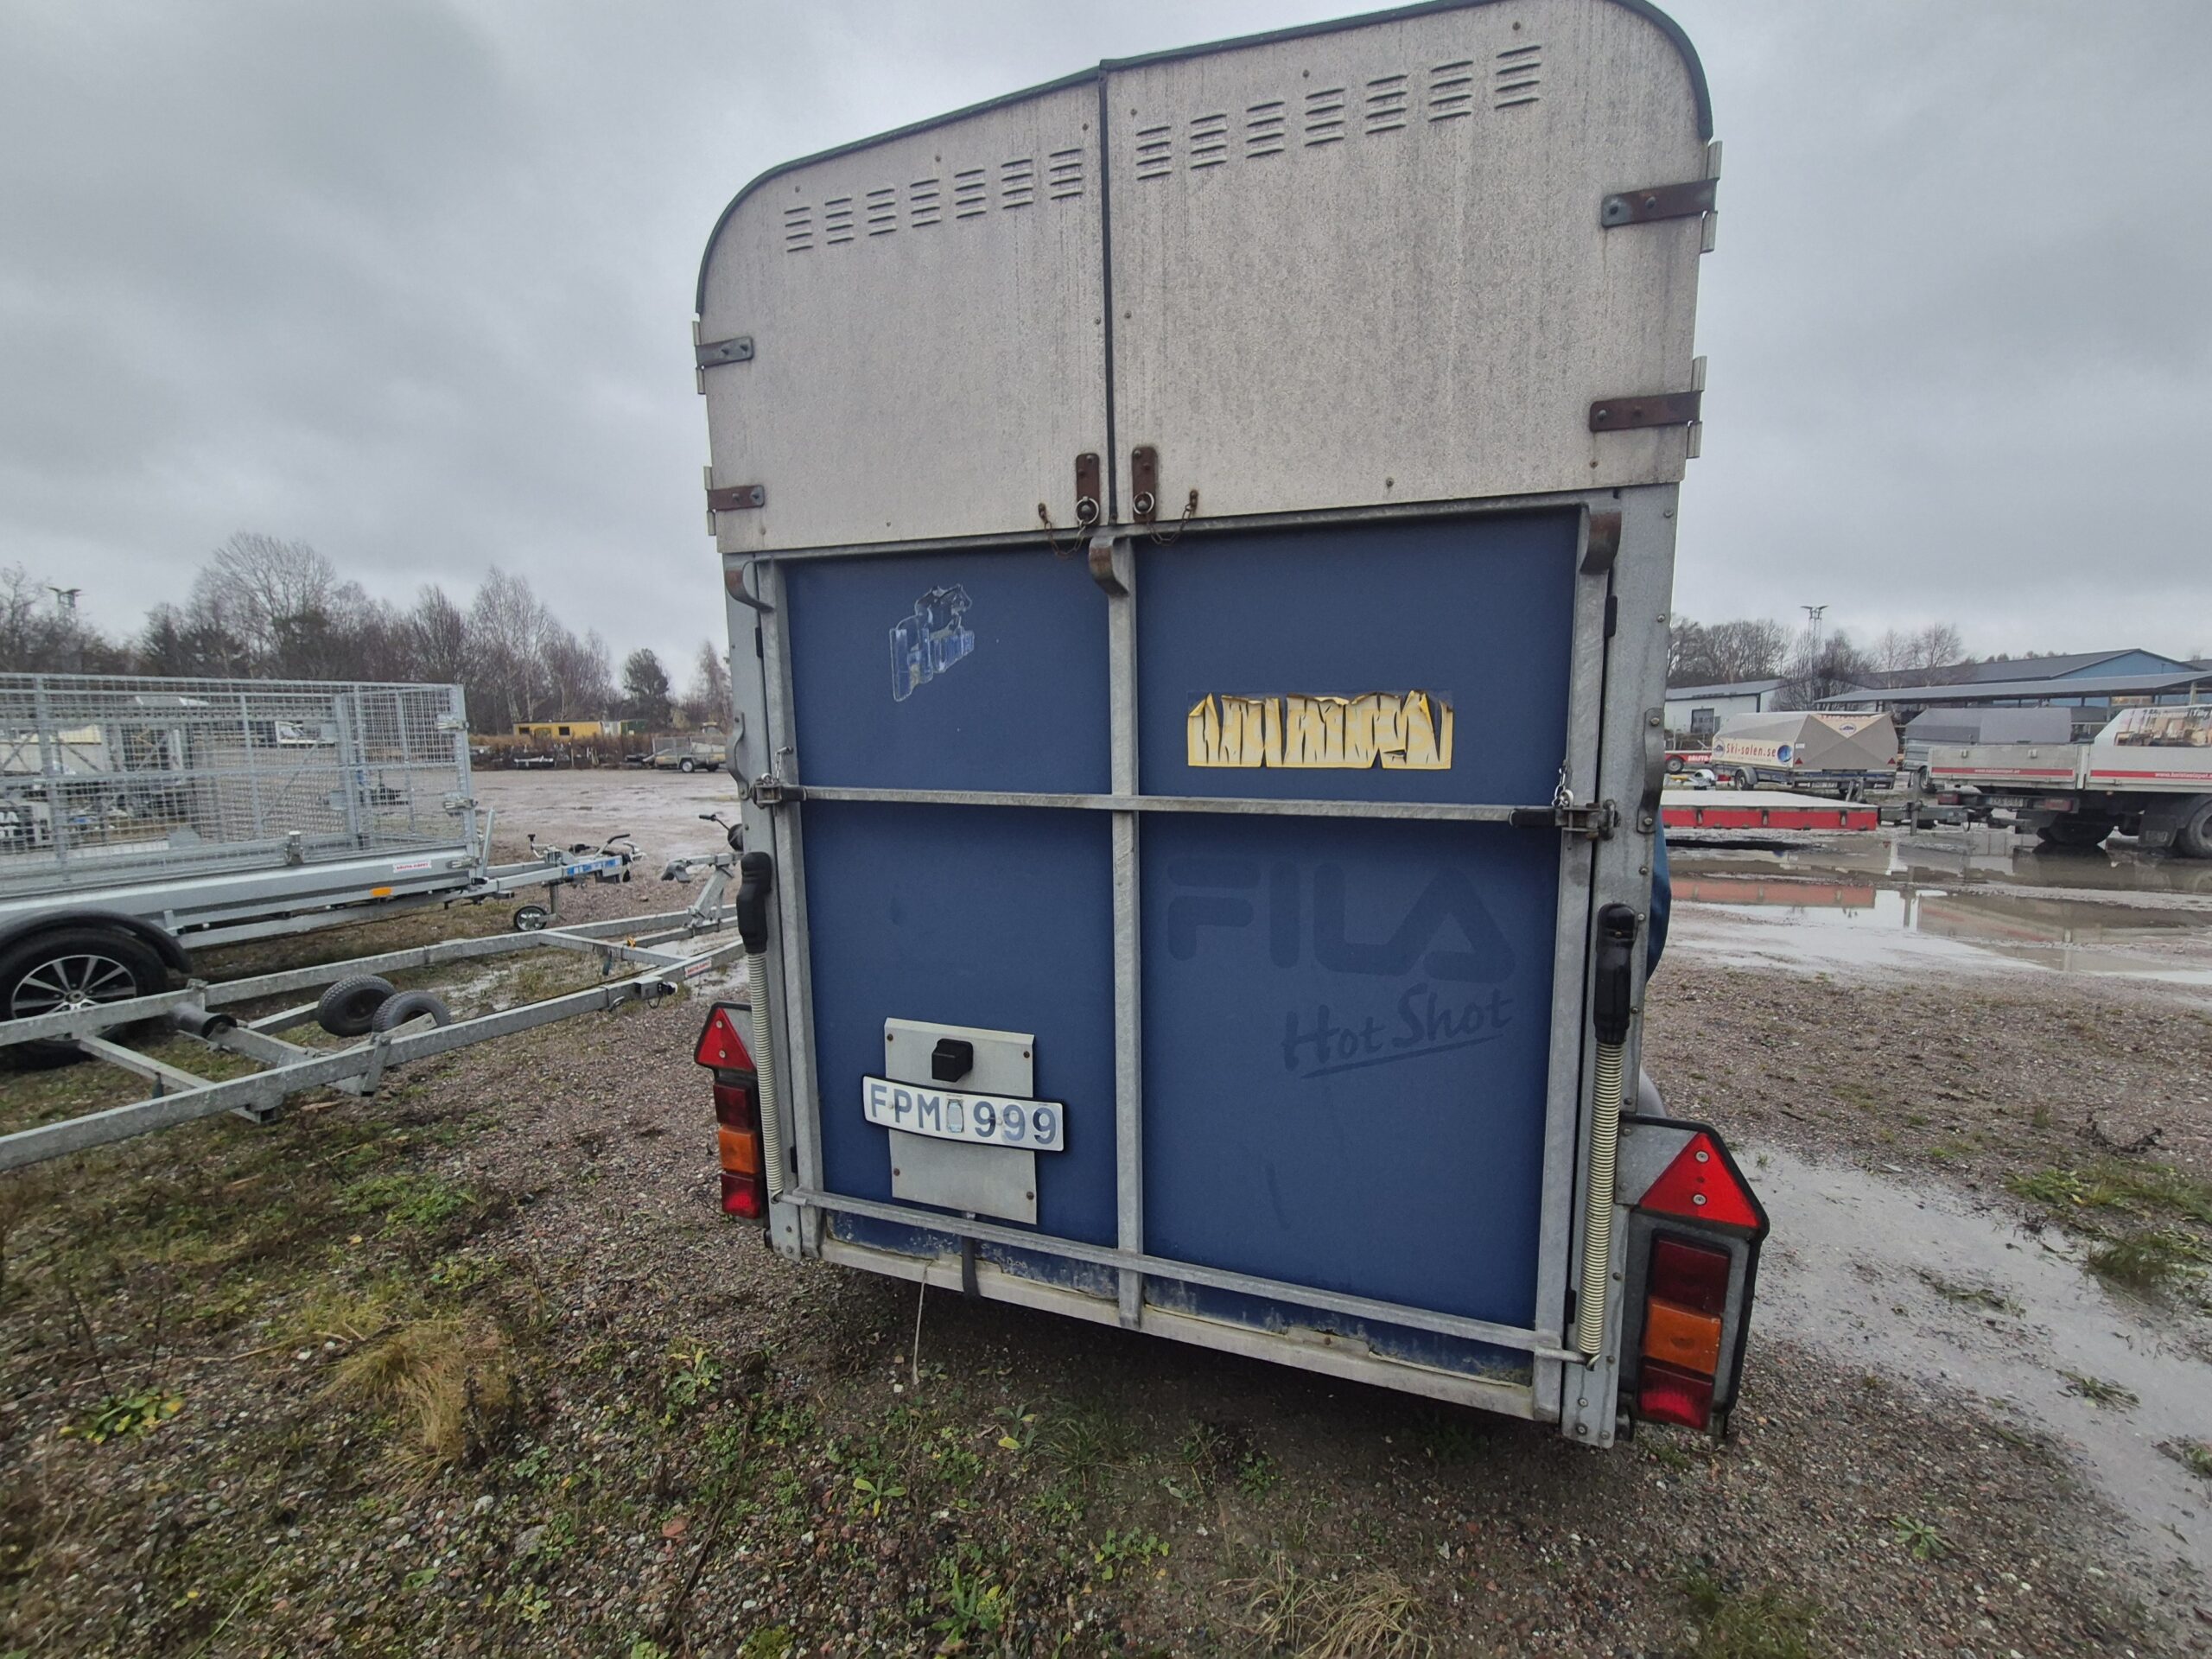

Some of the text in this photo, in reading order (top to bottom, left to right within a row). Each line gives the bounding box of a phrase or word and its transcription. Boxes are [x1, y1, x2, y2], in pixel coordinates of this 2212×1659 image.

[1166, 860, 1516, 983] FILA
[1281, 982, 1513, 1071] Hot Shot
[870, 1084, 1057, 1145] FPM 999
